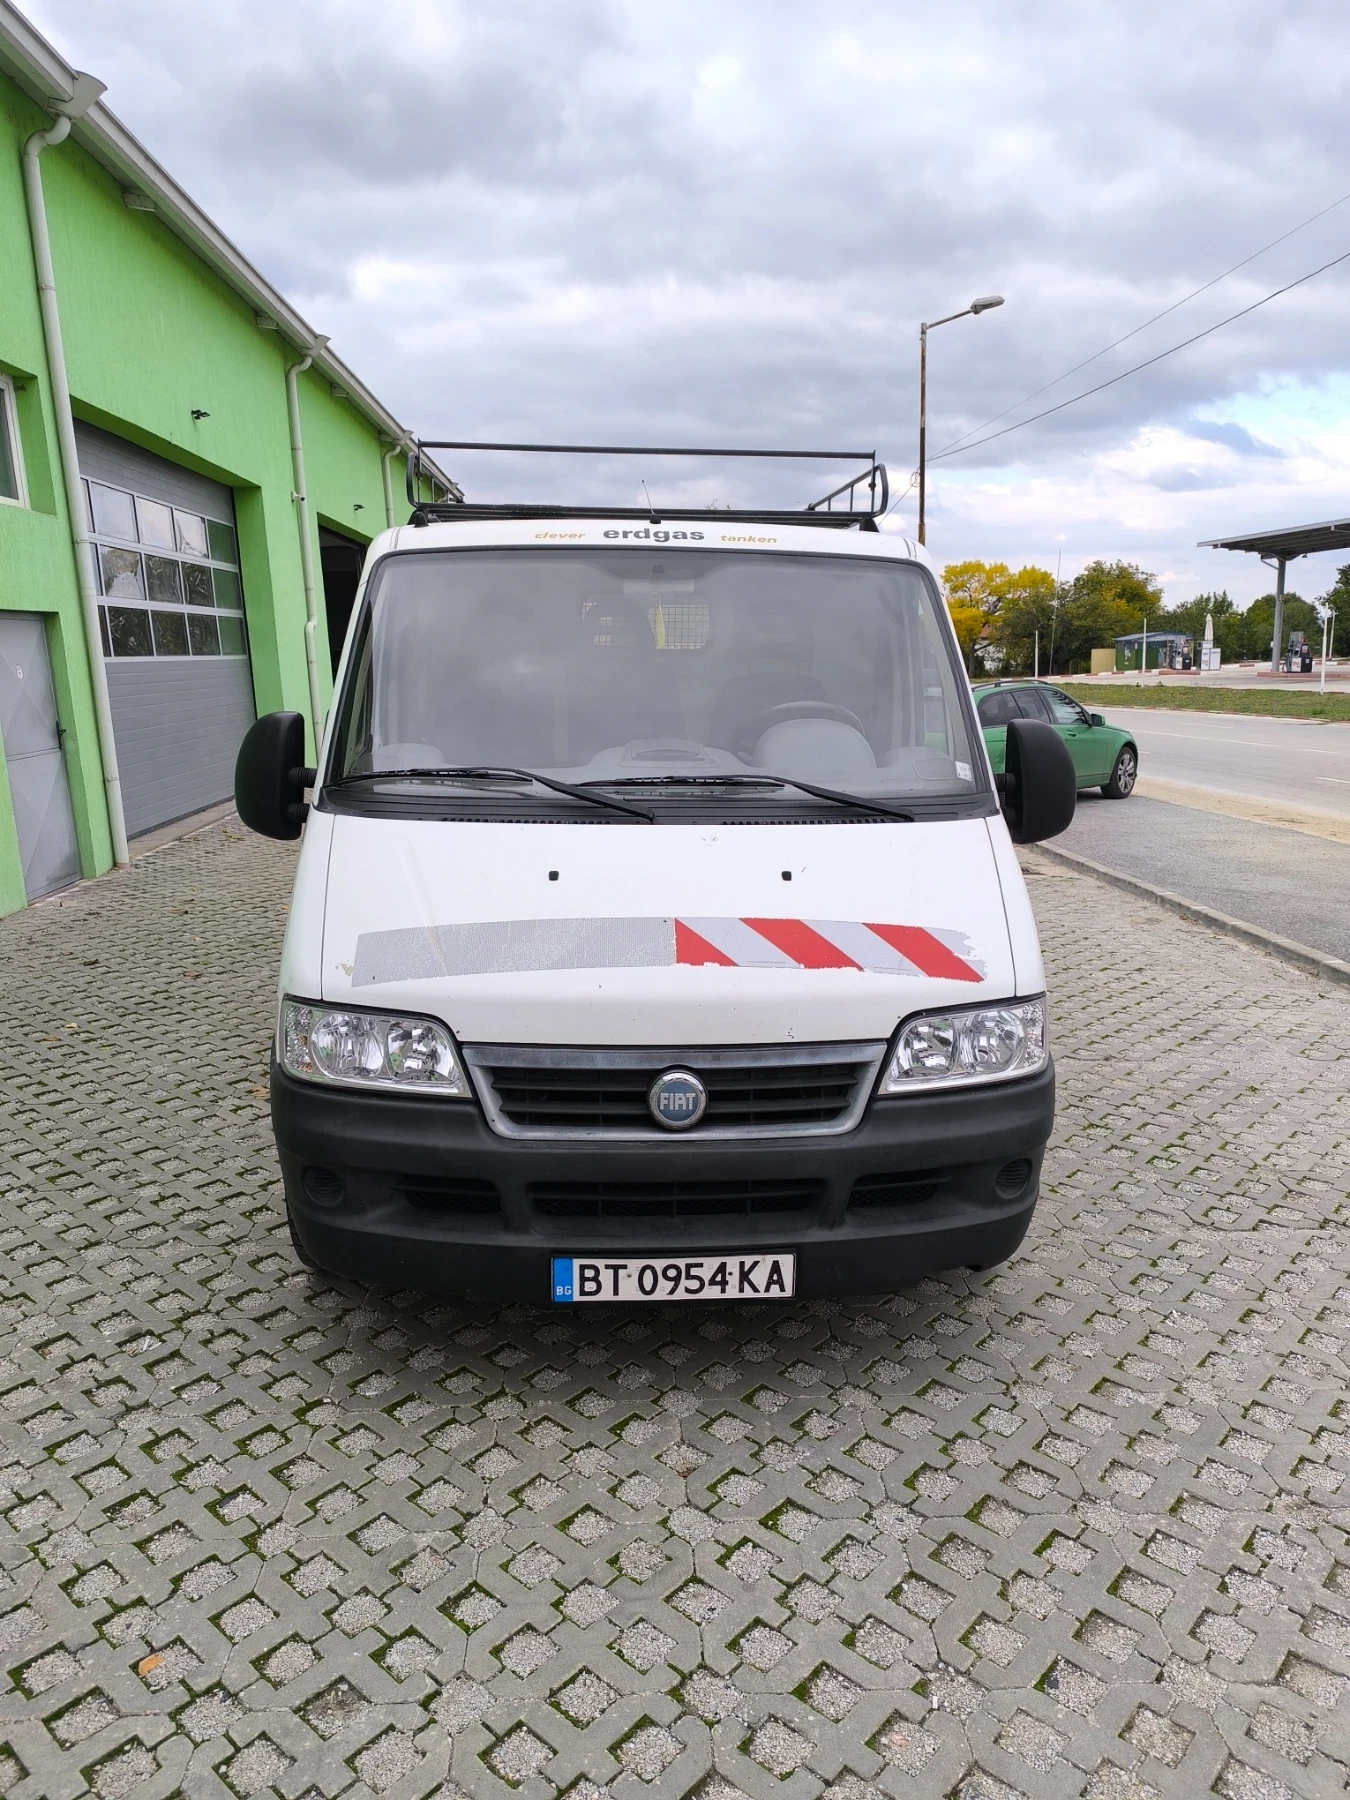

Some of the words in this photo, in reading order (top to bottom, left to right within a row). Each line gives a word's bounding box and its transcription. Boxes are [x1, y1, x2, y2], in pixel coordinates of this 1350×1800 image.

[534, 531, 586, 539] clever
[603, 528, 705, 543] erdgas
[720, 535, 777, 543] tanken
[660, 1092, 696, 1111] FIAT
[579, 1264, 628, 1297] BT
[637, 1261, 729, 1297] 0954
[738, 1260, 786, 1294] KA
[556, 1285, 572, 1296] BG
